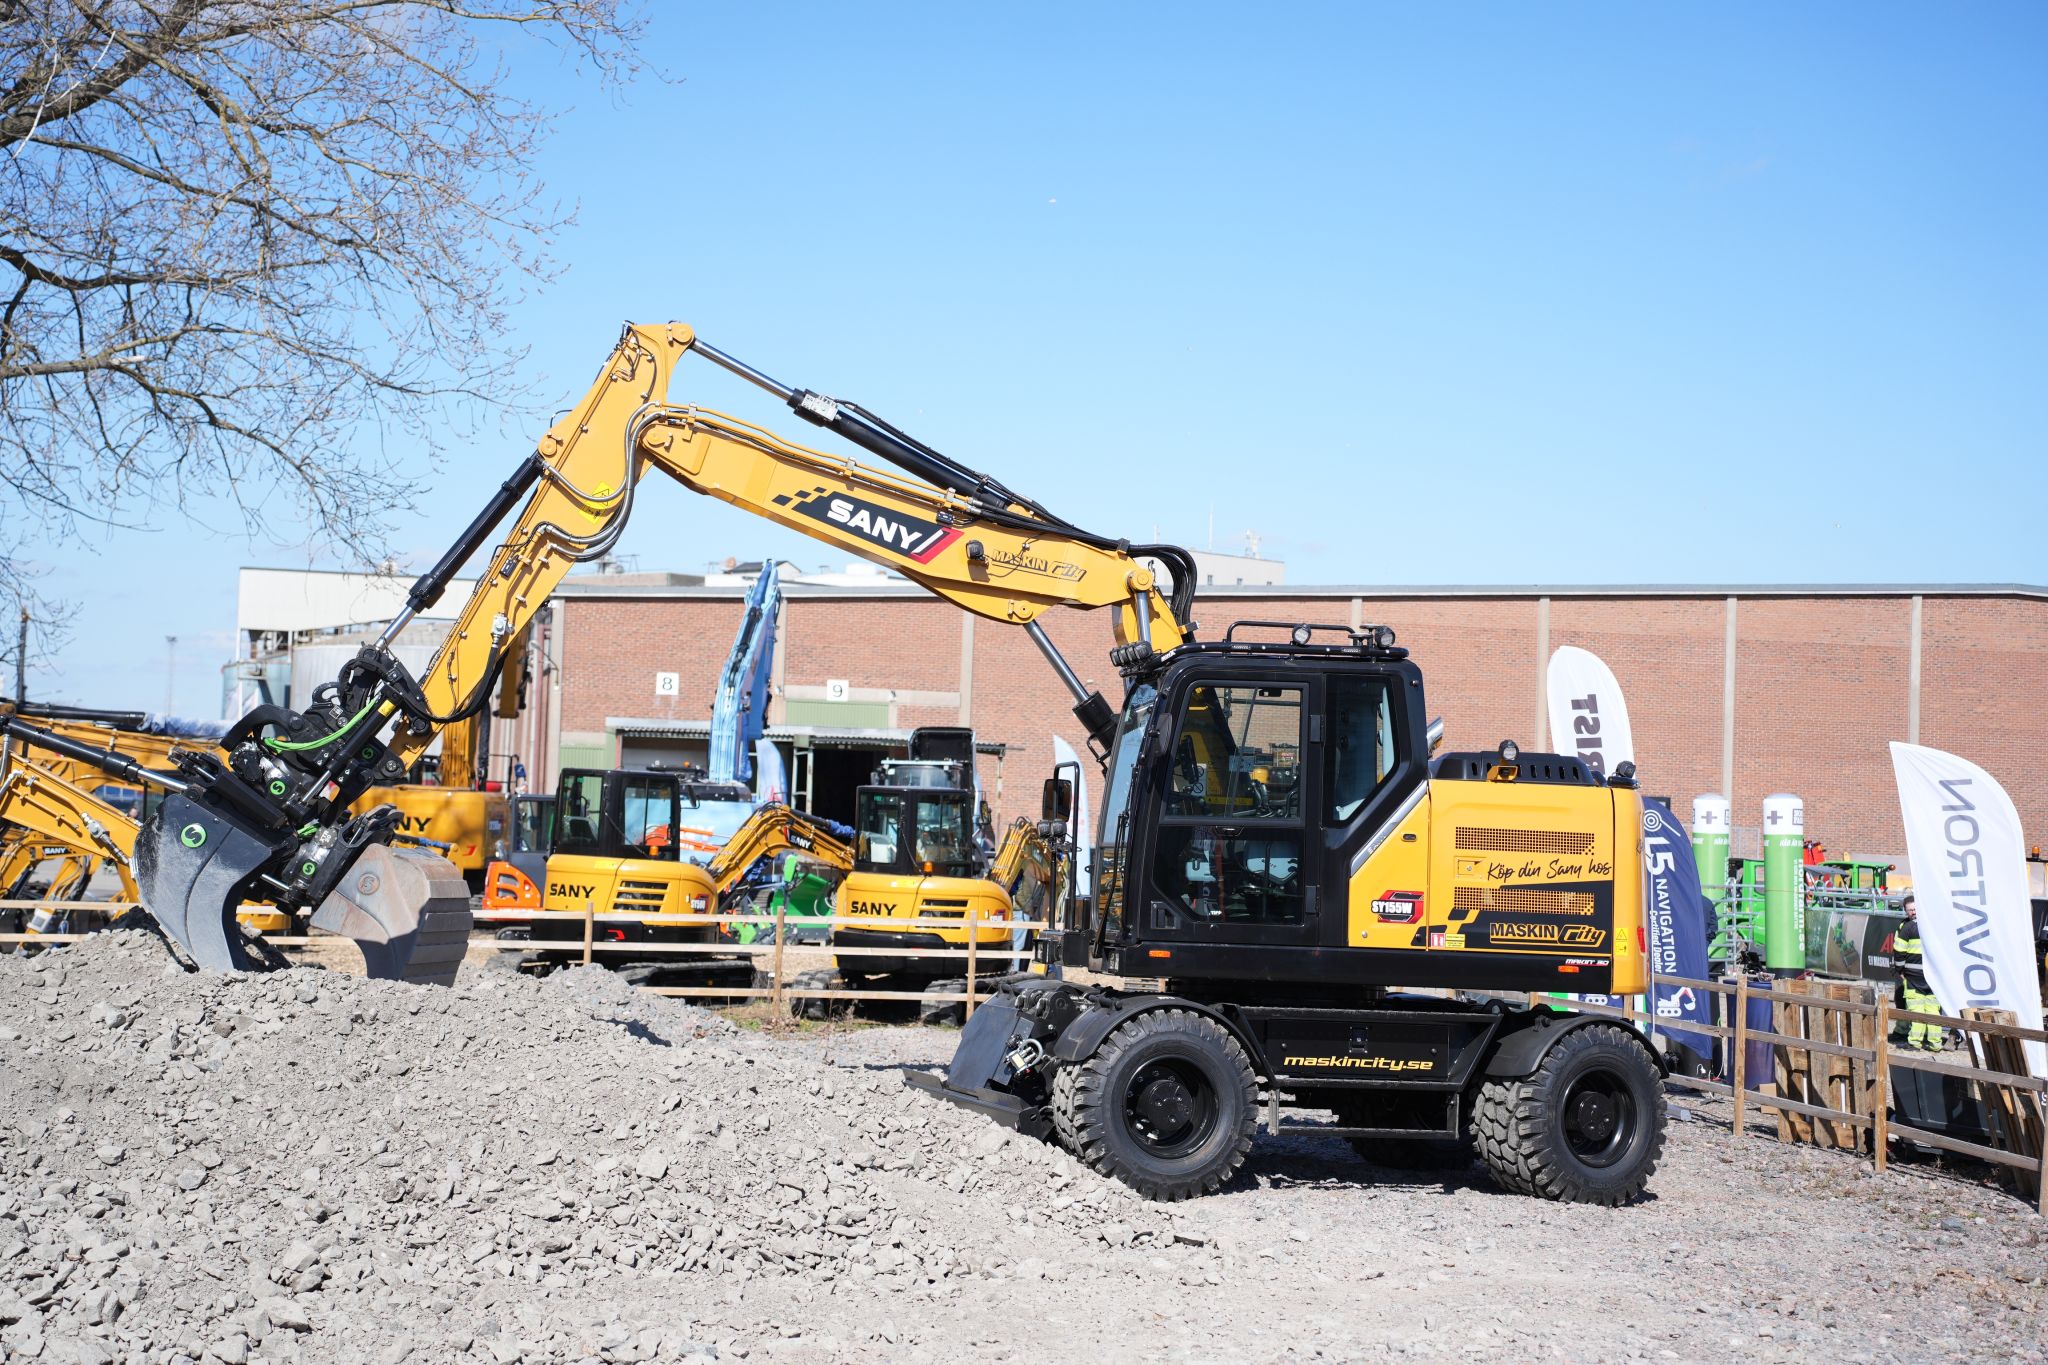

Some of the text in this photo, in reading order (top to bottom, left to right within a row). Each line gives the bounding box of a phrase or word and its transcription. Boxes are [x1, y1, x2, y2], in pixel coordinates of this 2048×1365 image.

[827, 498, 922, 550] SANY
[992, 550, 1049, 573] MASKIN
[661, 677, 673, 691] 8
[832, 684, 844, 698] 9
[396, 816, 432, 832] NY
[790, 836, 811, 849] SANY
[44, 847, 66, 855] SANY
[1644, 836, 1676, 876] L5
[1487, 858, 1613, 883] Köp din Sany hos
[550, 884, 595, 899] SANY
[851, 901, 897, 916] SANY
[1371, 900, 1413, 914] SY155W
[1490, 922, 1559, 940] MASKIN
[1655, 878, 1677, 973] NAVIGATION
[1283, 1055, 1434, 1071] maskincity.se
